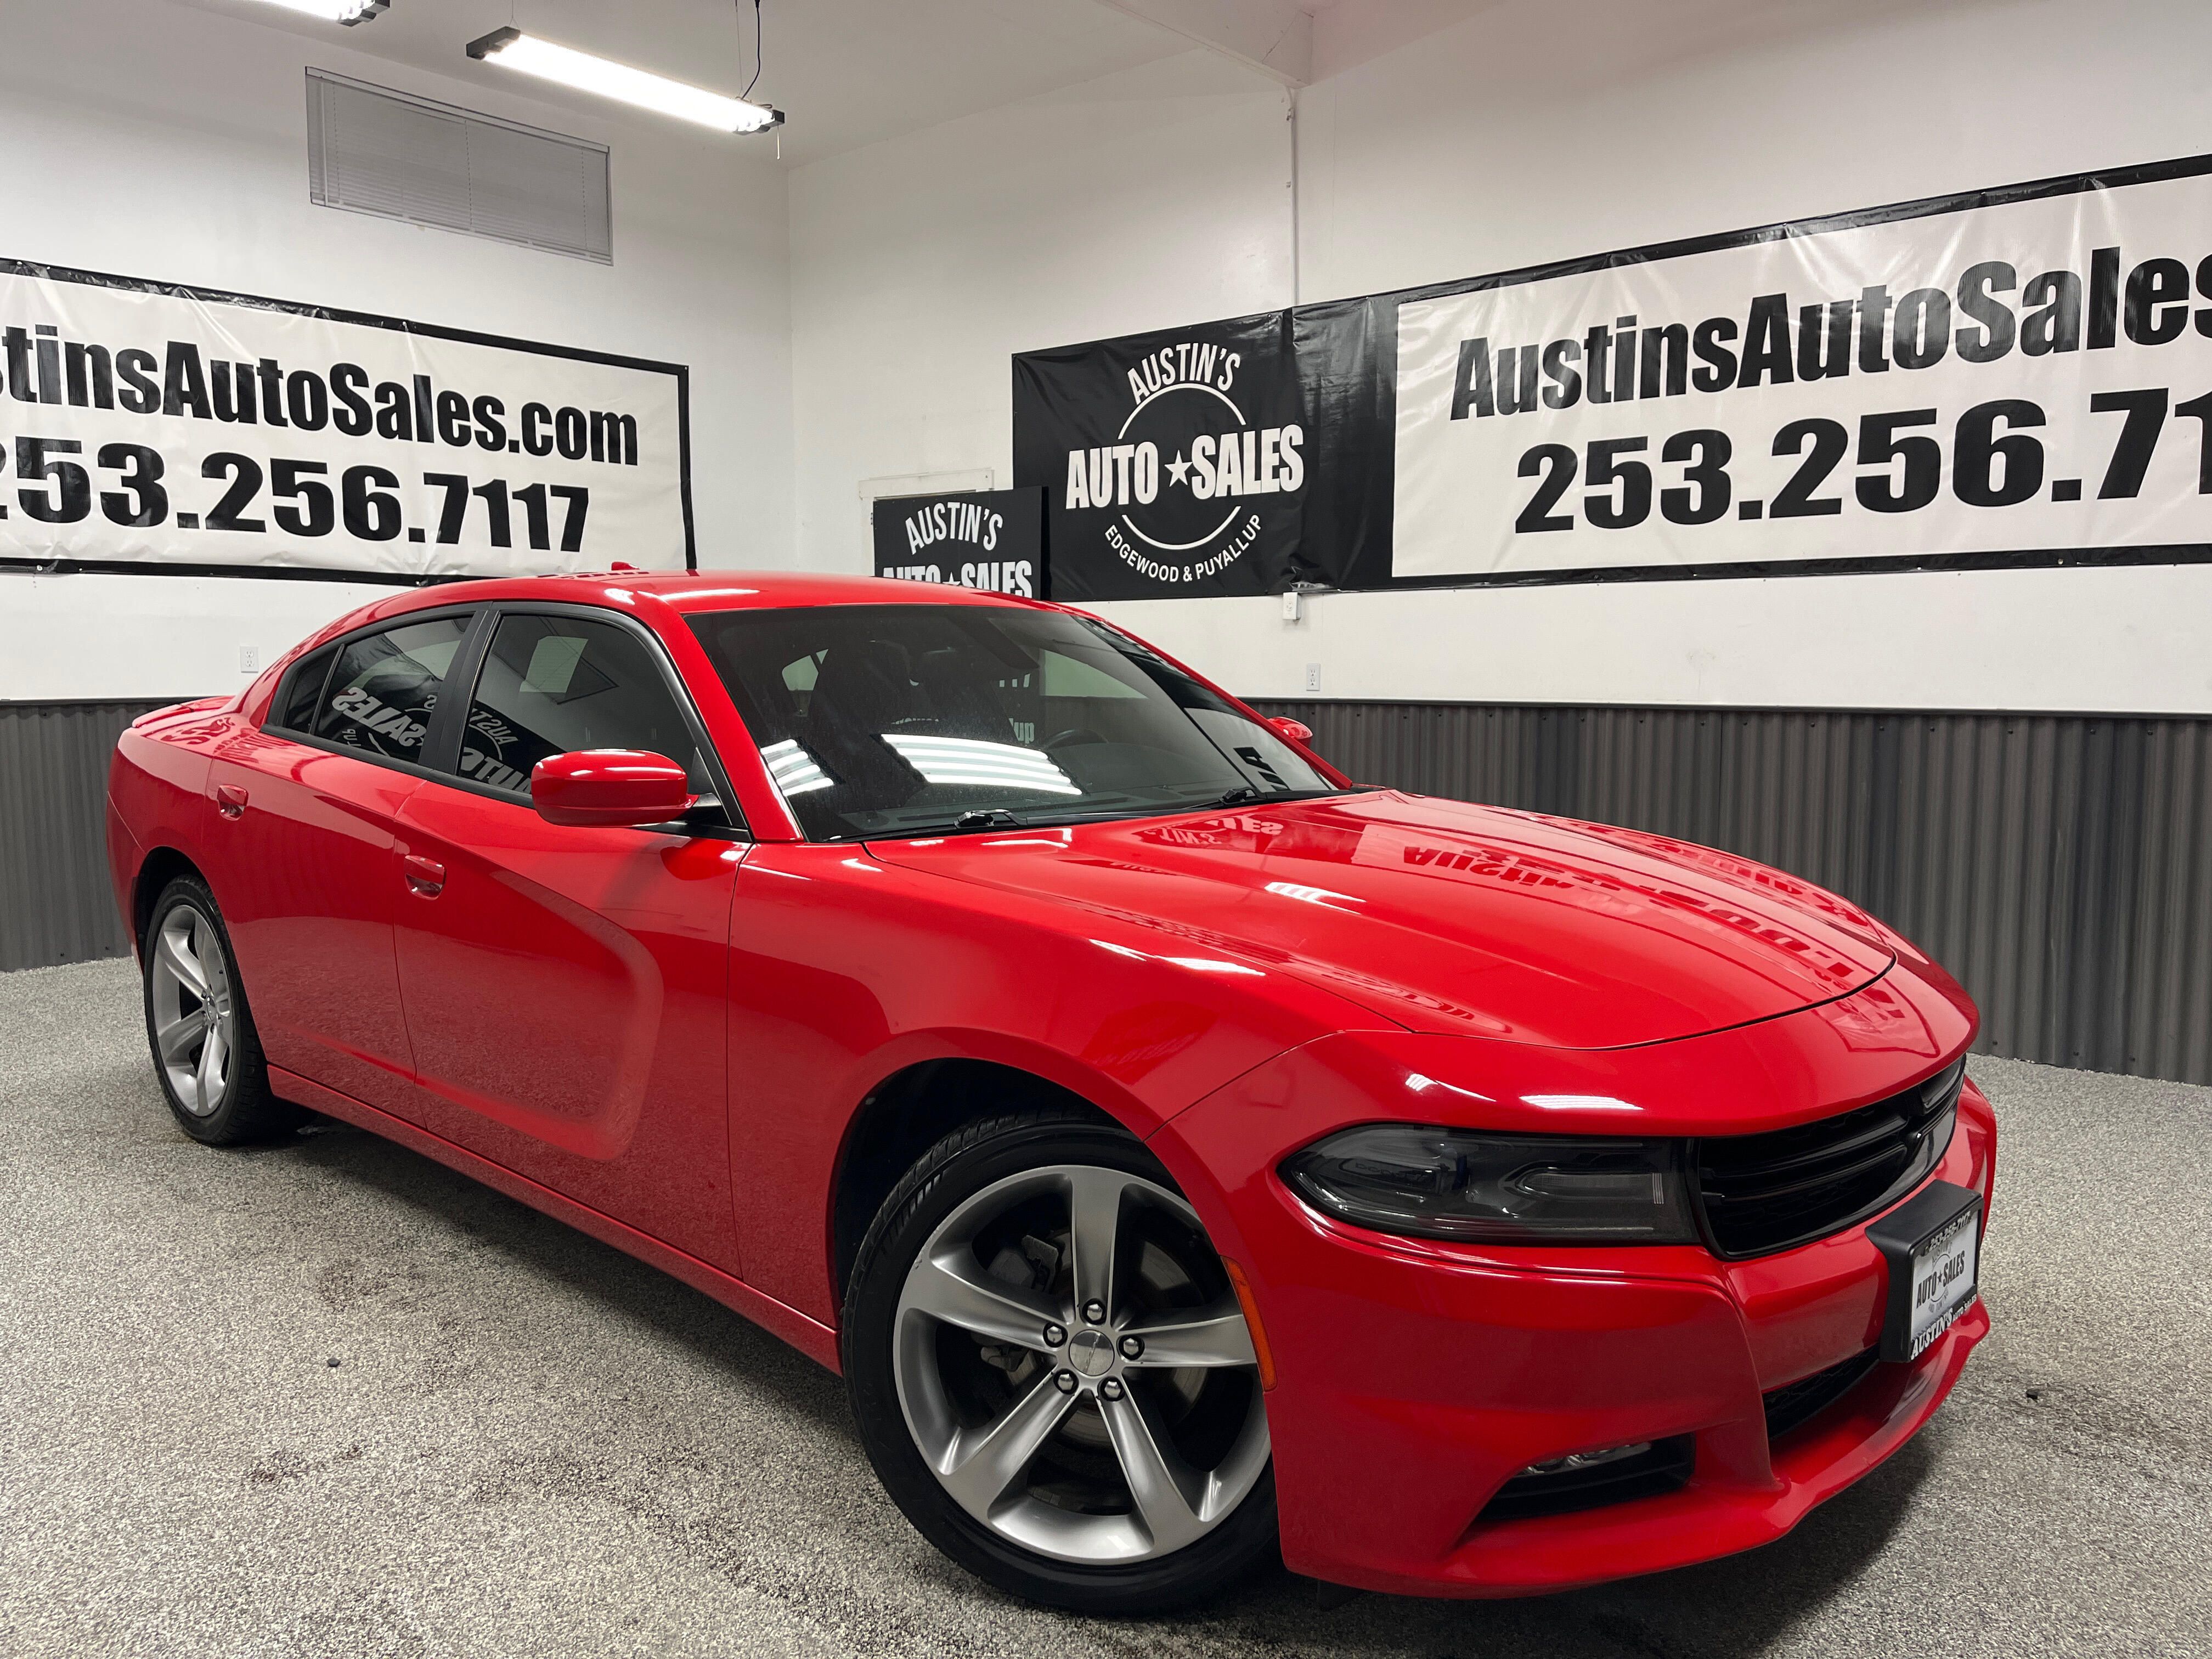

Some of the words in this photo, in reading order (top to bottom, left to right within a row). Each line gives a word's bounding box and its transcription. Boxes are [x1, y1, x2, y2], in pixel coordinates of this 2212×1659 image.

[0, 324, 637, 466] tinsAutoSales.com
[1127, 343, 1240, 405] AUSTIN'S
[0, 436, 589, 552] 53.256.7117
[1066, 442, 1158, 510] AUTO
[1192, 425, 1304, 499] SALES
[905, 502, 1003, 555] AUSTIN'S
[1105, 525, 1179, 582] EDGEWOOD
[1183, 566, 1193, 582] &
[1195, 515, 1261, 579] PUYALLUP
[1916, 1271, 1937, 1308] AUTO
[1943, 1250, 1965, 1288] SALES
